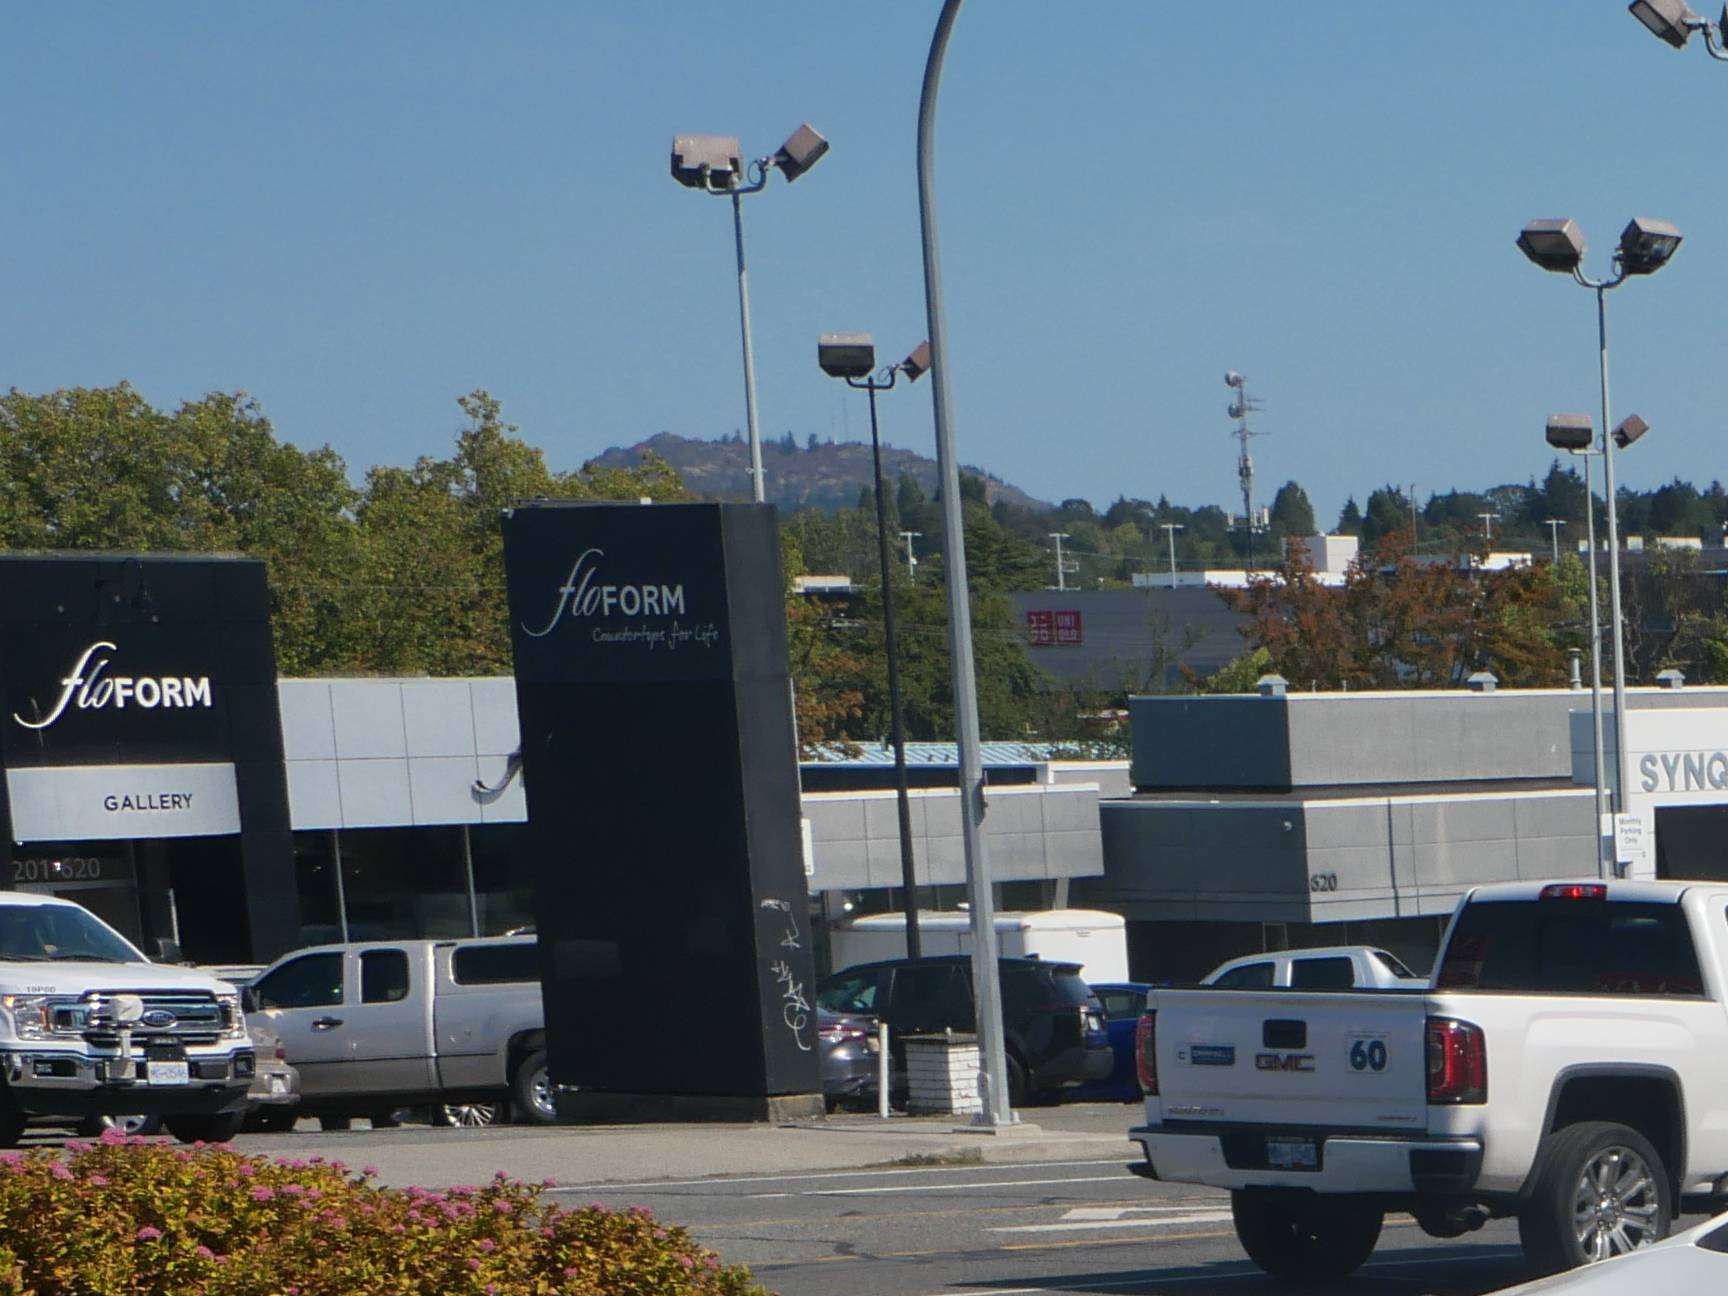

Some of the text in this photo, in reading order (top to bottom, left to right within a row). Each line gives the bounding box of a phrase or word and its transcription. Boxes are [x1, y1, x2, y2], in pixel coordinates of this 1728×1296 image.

[520, 548, 686, 637] floFORM
[667, 619, 691, 649] for
[695, 622, 719, 648] Life
[14, 641, 212, 729] floFORM
[104, 793, 192, 811] GALLERY
[1255, 1054, 1315, 1072] GMC
[1351, 1040, 1387, 1071] 60
